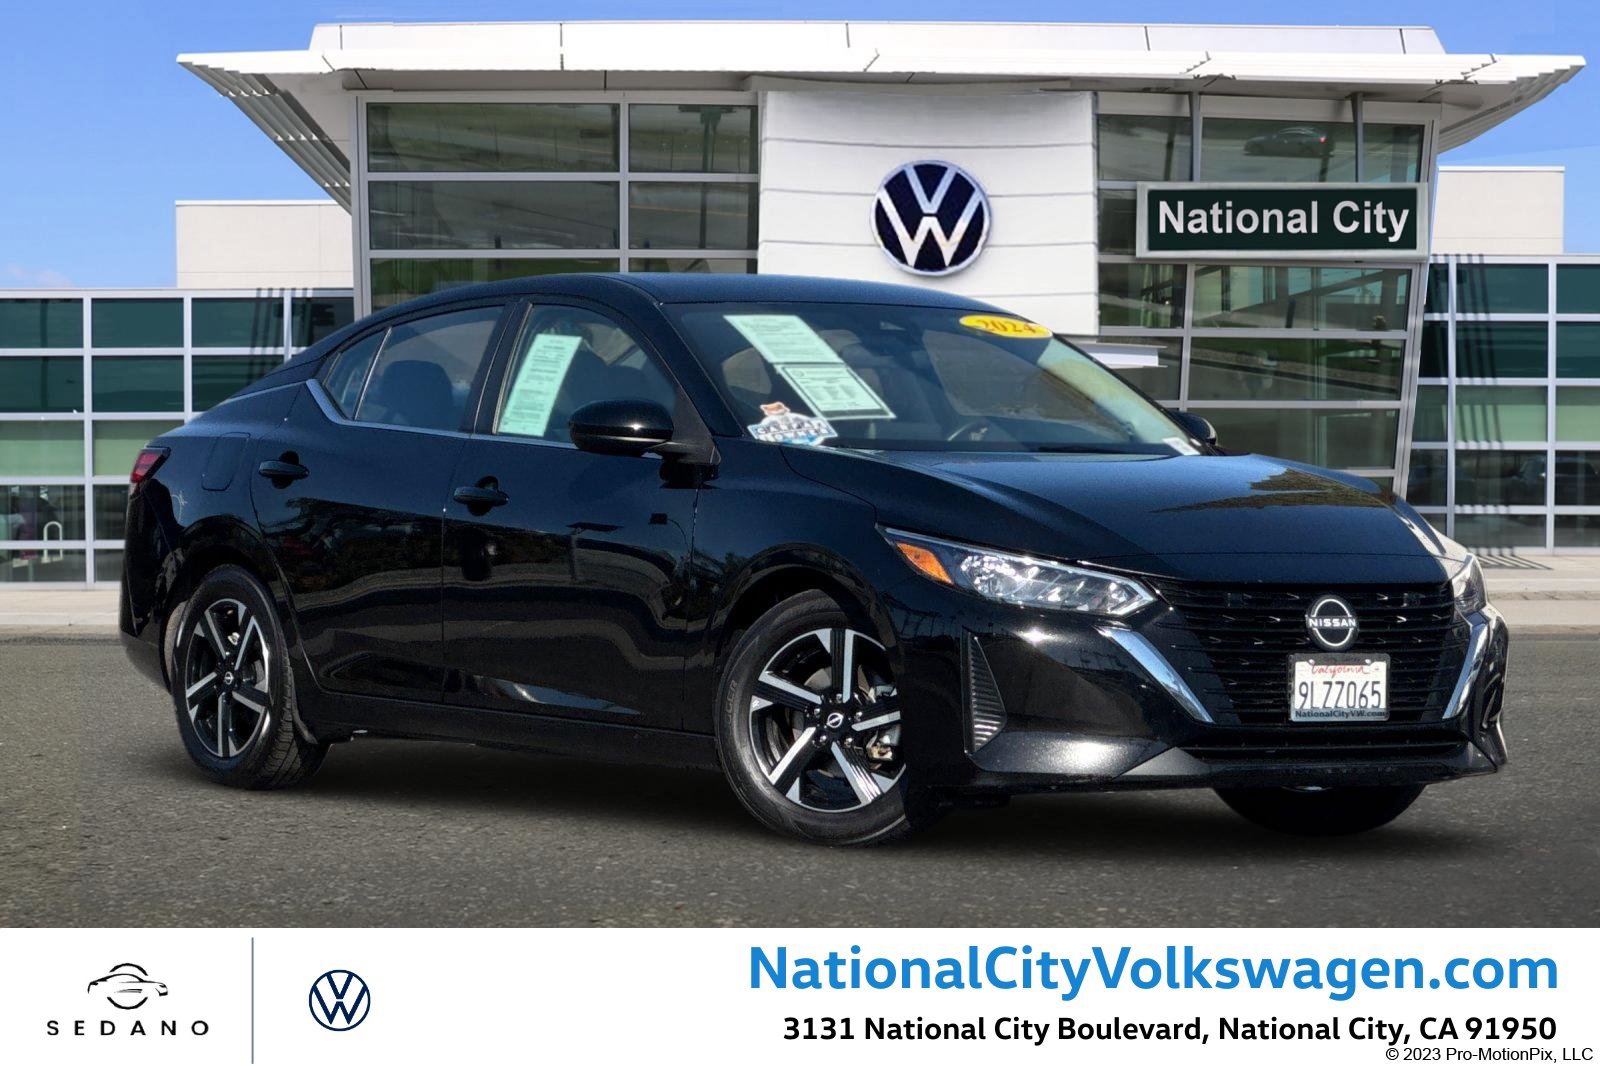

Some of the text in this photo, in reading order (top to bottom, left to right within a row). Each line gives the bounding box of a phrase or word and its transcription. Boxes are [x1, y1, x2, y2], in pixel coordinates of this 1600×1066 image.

[1158, 200, 1410, 243] National City
[975, 319, 1036, 334] 2024
[1308, 618, 1356, 627] NISSAN
[1295, 710, 1387, 718] NationalCityVW.com
